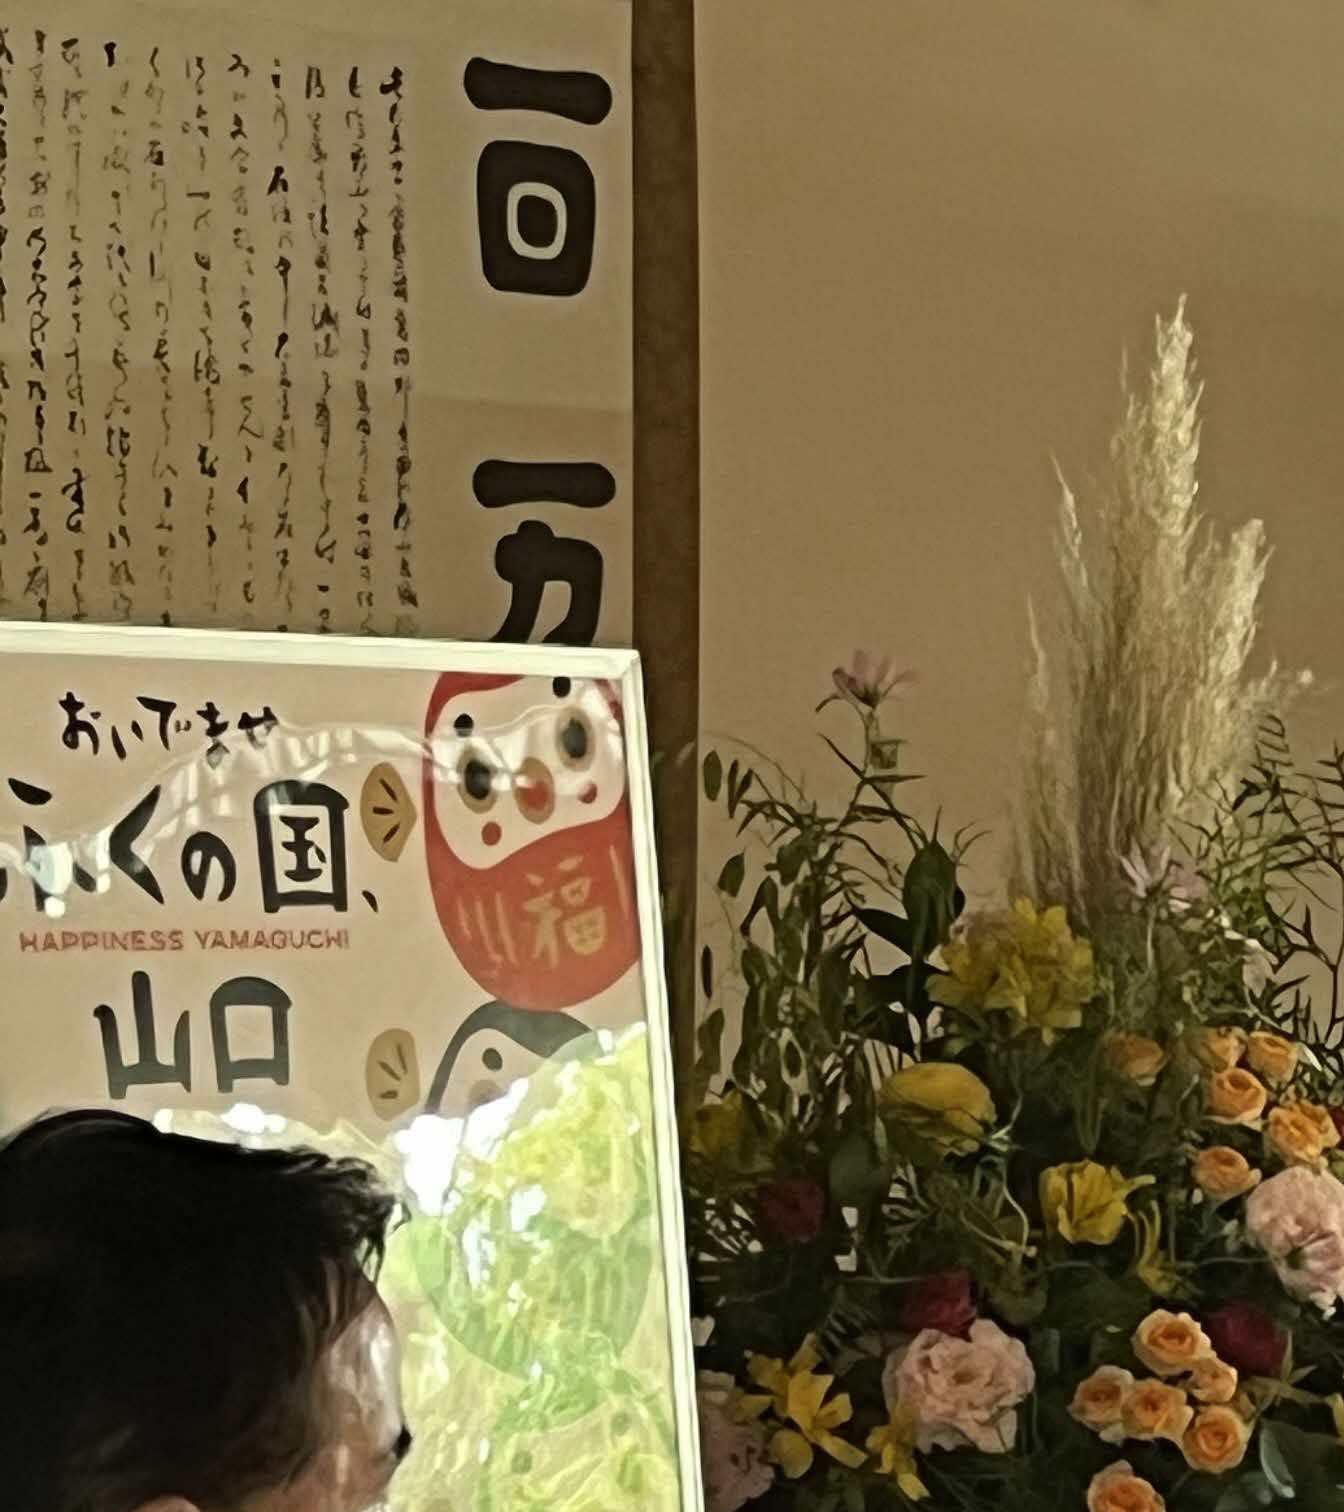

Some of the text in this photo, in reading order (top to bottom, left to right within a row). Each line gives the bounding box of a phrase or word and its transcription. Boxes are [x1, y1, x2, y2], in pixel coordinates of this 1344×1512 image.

[58, 691, 278, 770] おいでませ
[19, 928, 349, 952] HAPPINESS YAMAGUCHI
[93, 970, 293, 1099] 山口
